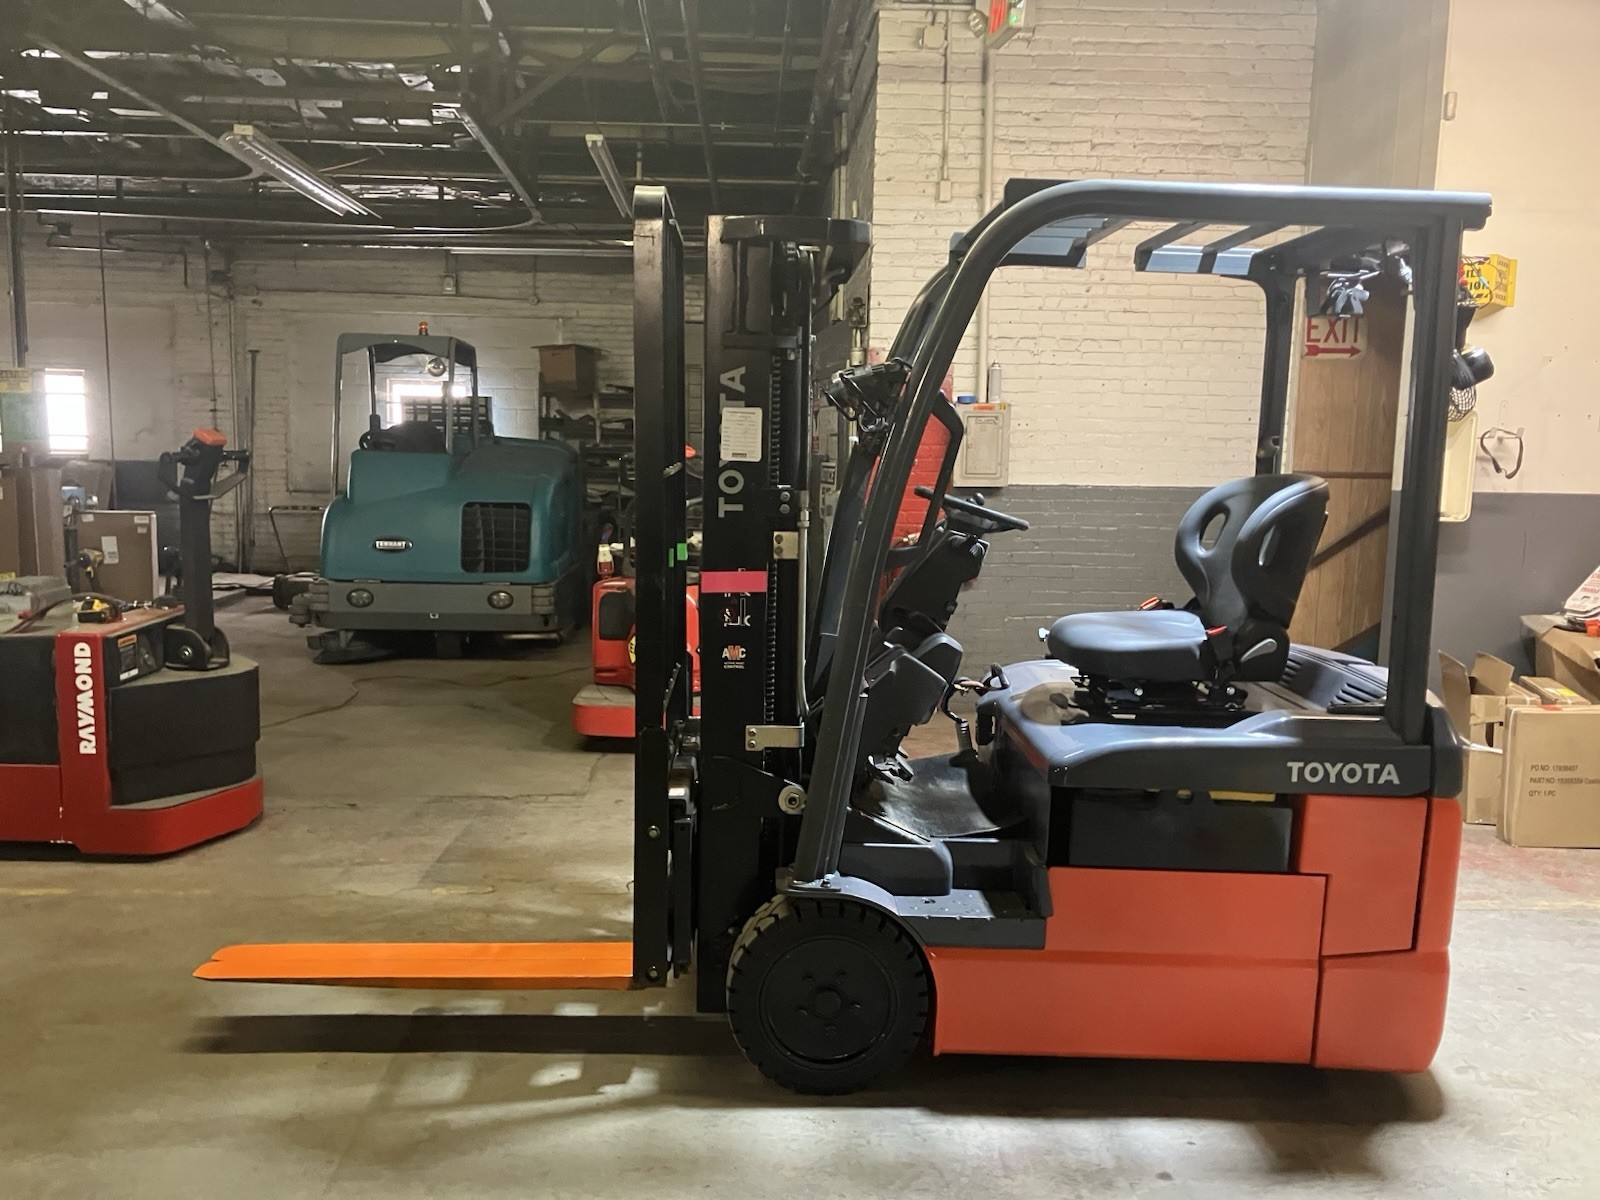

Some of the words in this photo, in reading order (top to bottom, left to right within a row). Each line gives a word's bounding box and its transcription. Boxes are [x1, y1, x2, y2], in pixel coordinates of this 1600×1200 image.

[717, 366, 746, 519] TOTA
[721, 645, 747, 661] AMC
[74, 642, 97, 755] RAYMOND
[1286, 761, 1400, 785] TOYOTA
